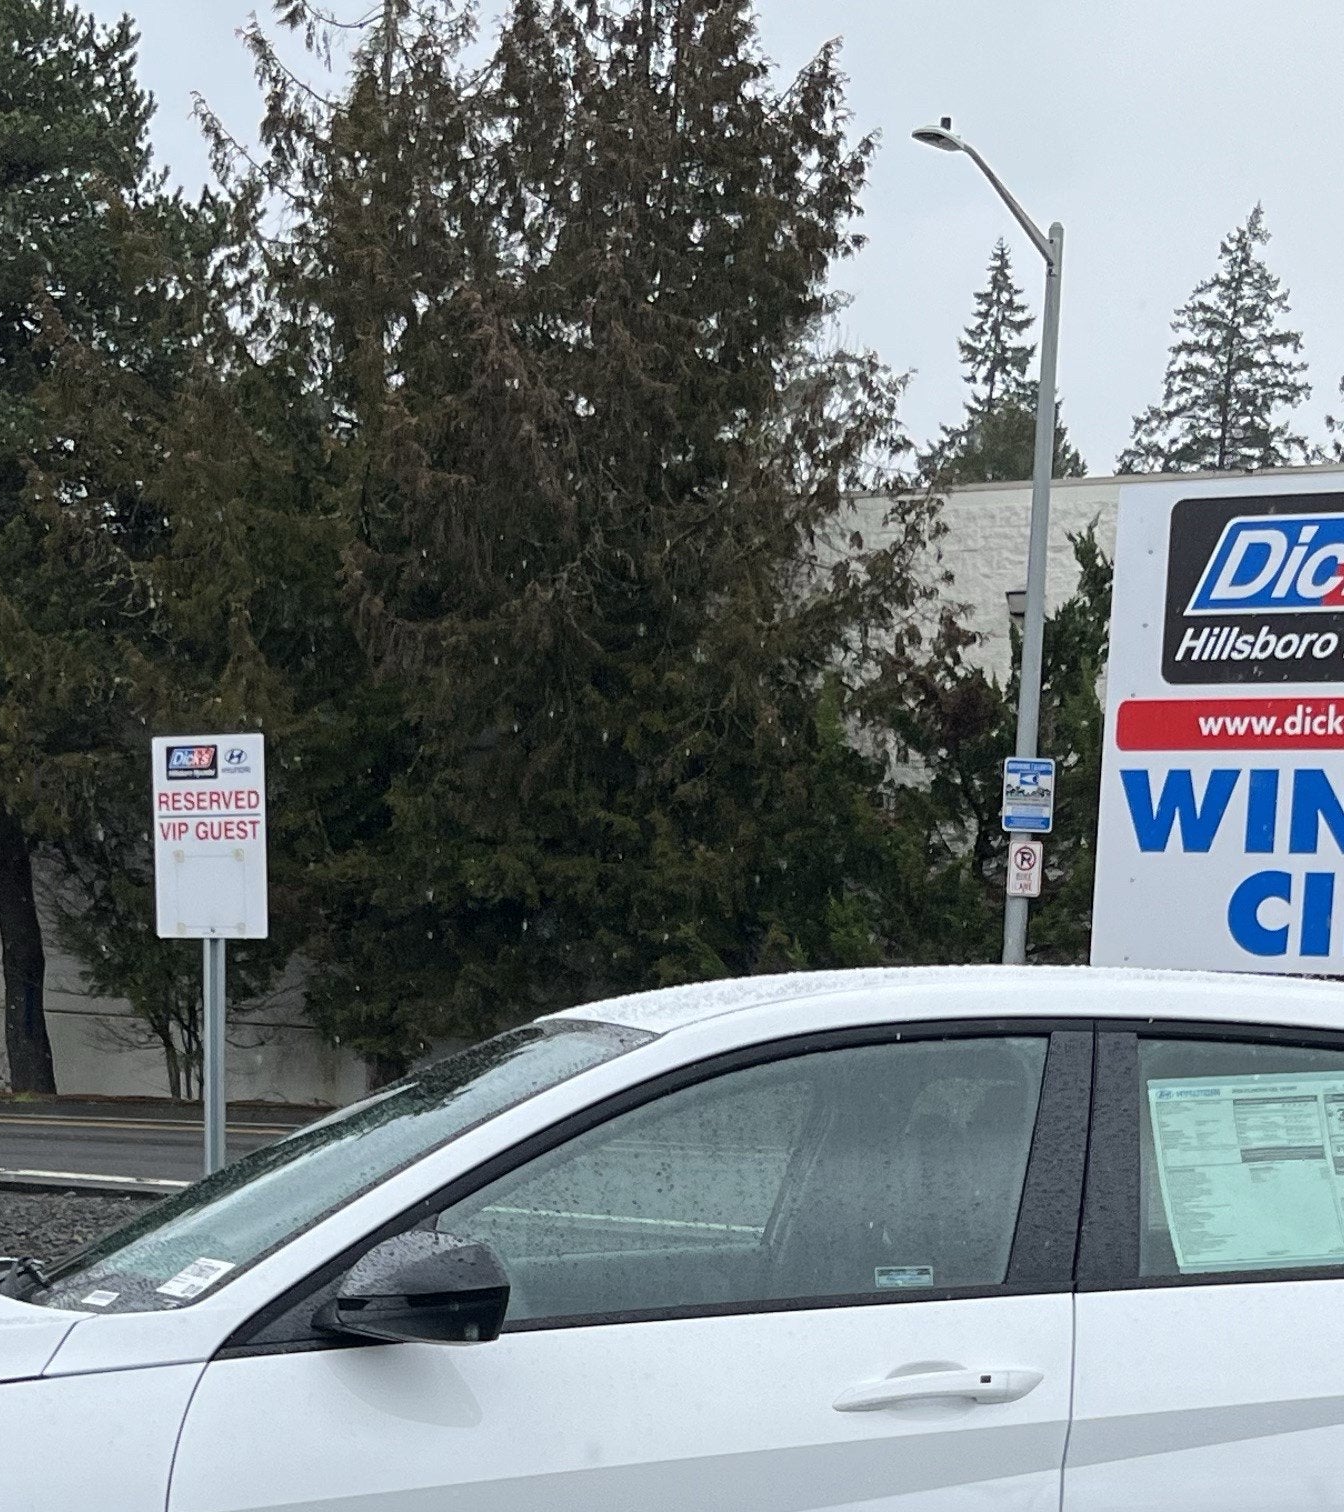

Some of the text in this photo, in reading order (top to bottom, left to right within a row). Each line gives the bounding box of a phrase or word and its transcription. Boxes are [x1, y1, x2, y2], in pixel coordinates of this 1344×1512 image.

[1173, 625, 1338, 663] Hillsboro
[158, 790, 260, 811] RESERVED
[160, 820, 261, 842] VIP GUEST
